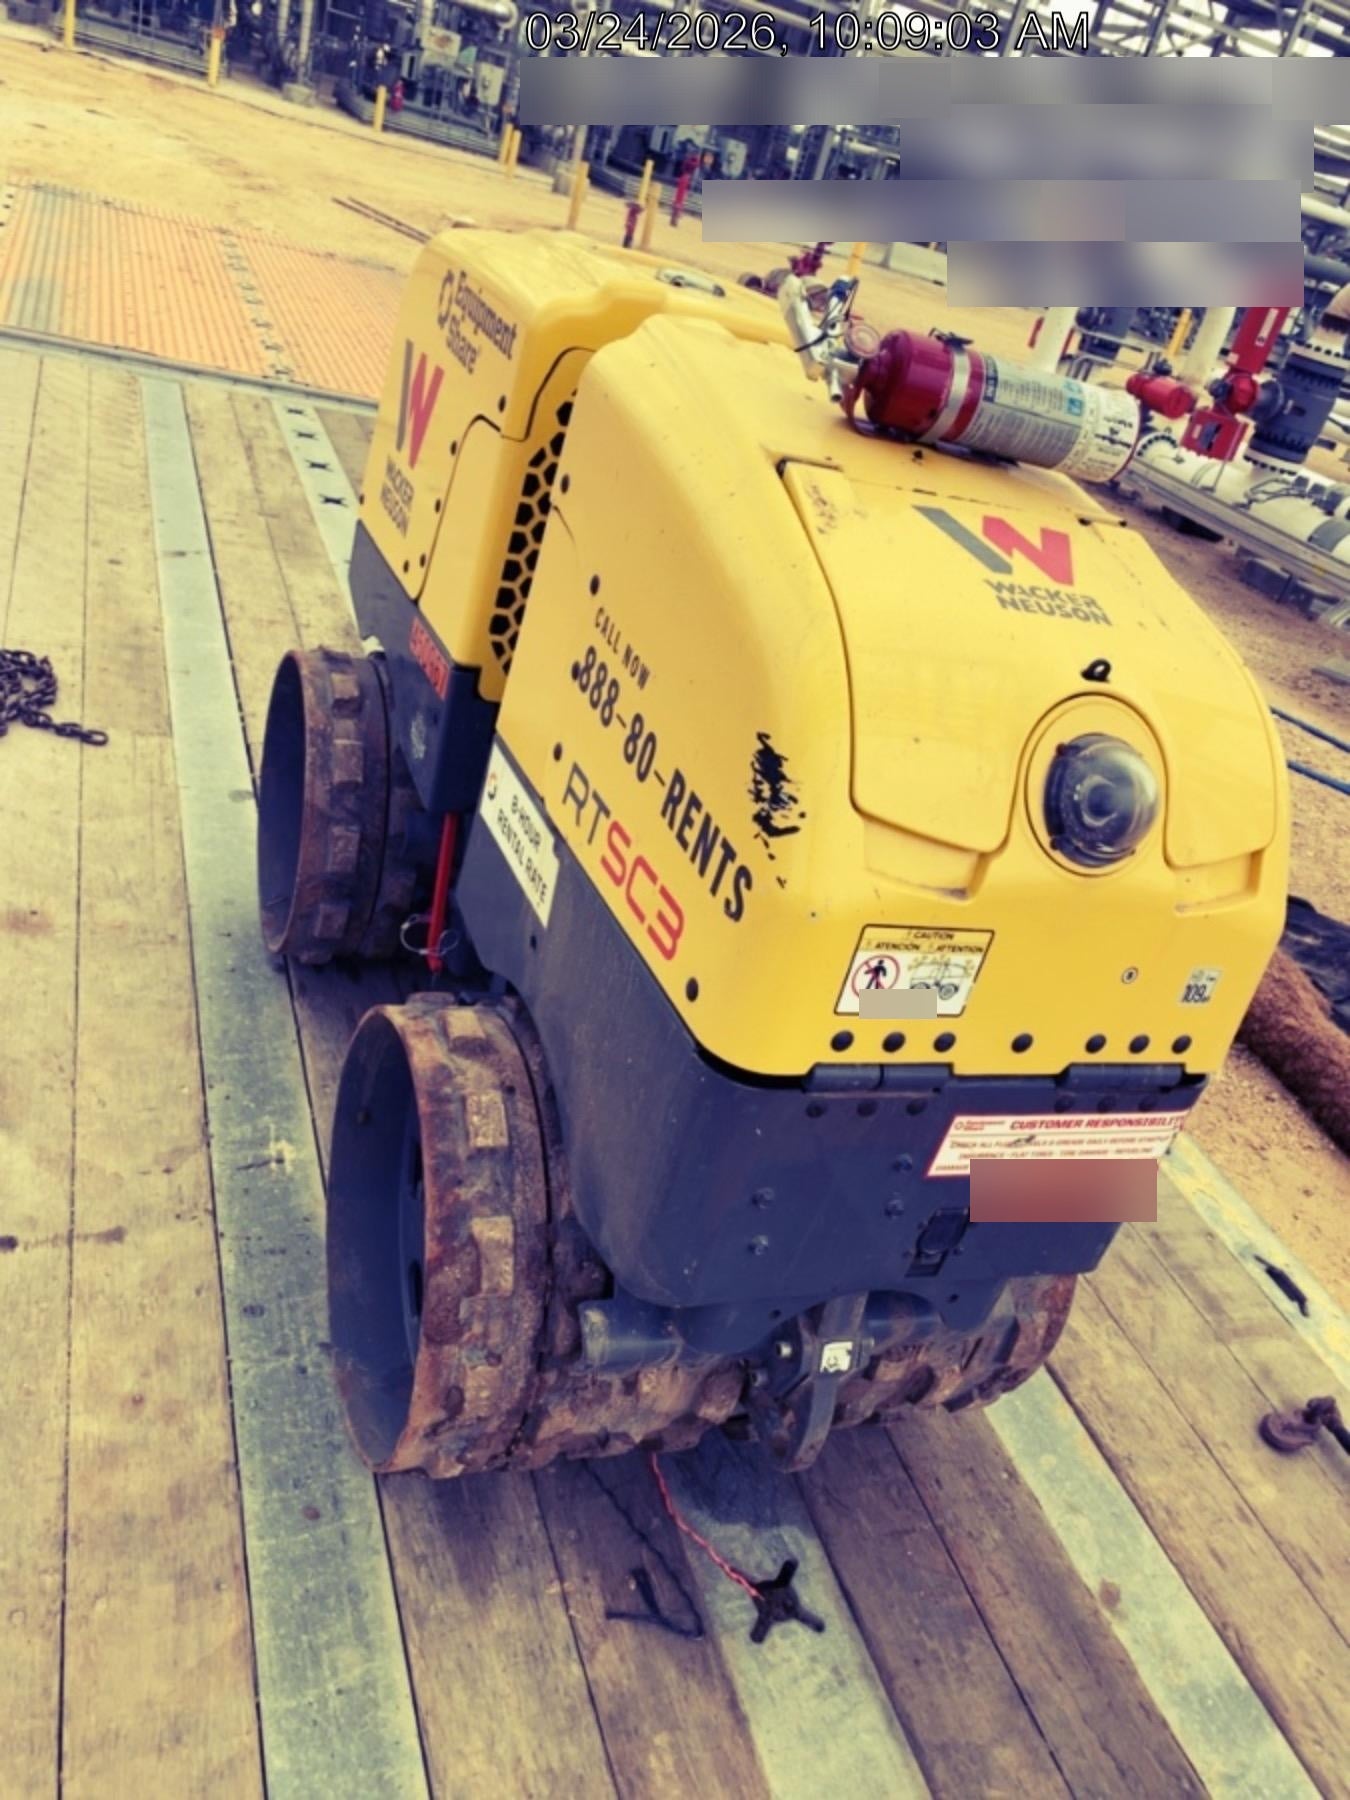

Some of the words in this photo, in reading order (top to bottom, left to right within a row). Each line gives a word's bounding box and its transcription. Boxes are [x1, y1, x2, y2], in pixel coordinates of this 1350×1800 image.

[455, 270, 517, 360] Equipment
[995, 595, 1112, 626] NEUSON
[596, 607, 621, 654] CALL
[622, 644, 650, 690] NOW
[497, 808, 525, 867] RENTAL
[525, 857, 548, 904] RATE
[912, 930, 955, 940] CAUTION
[1010, 1119, 1083, 1130] CUSTOMER
